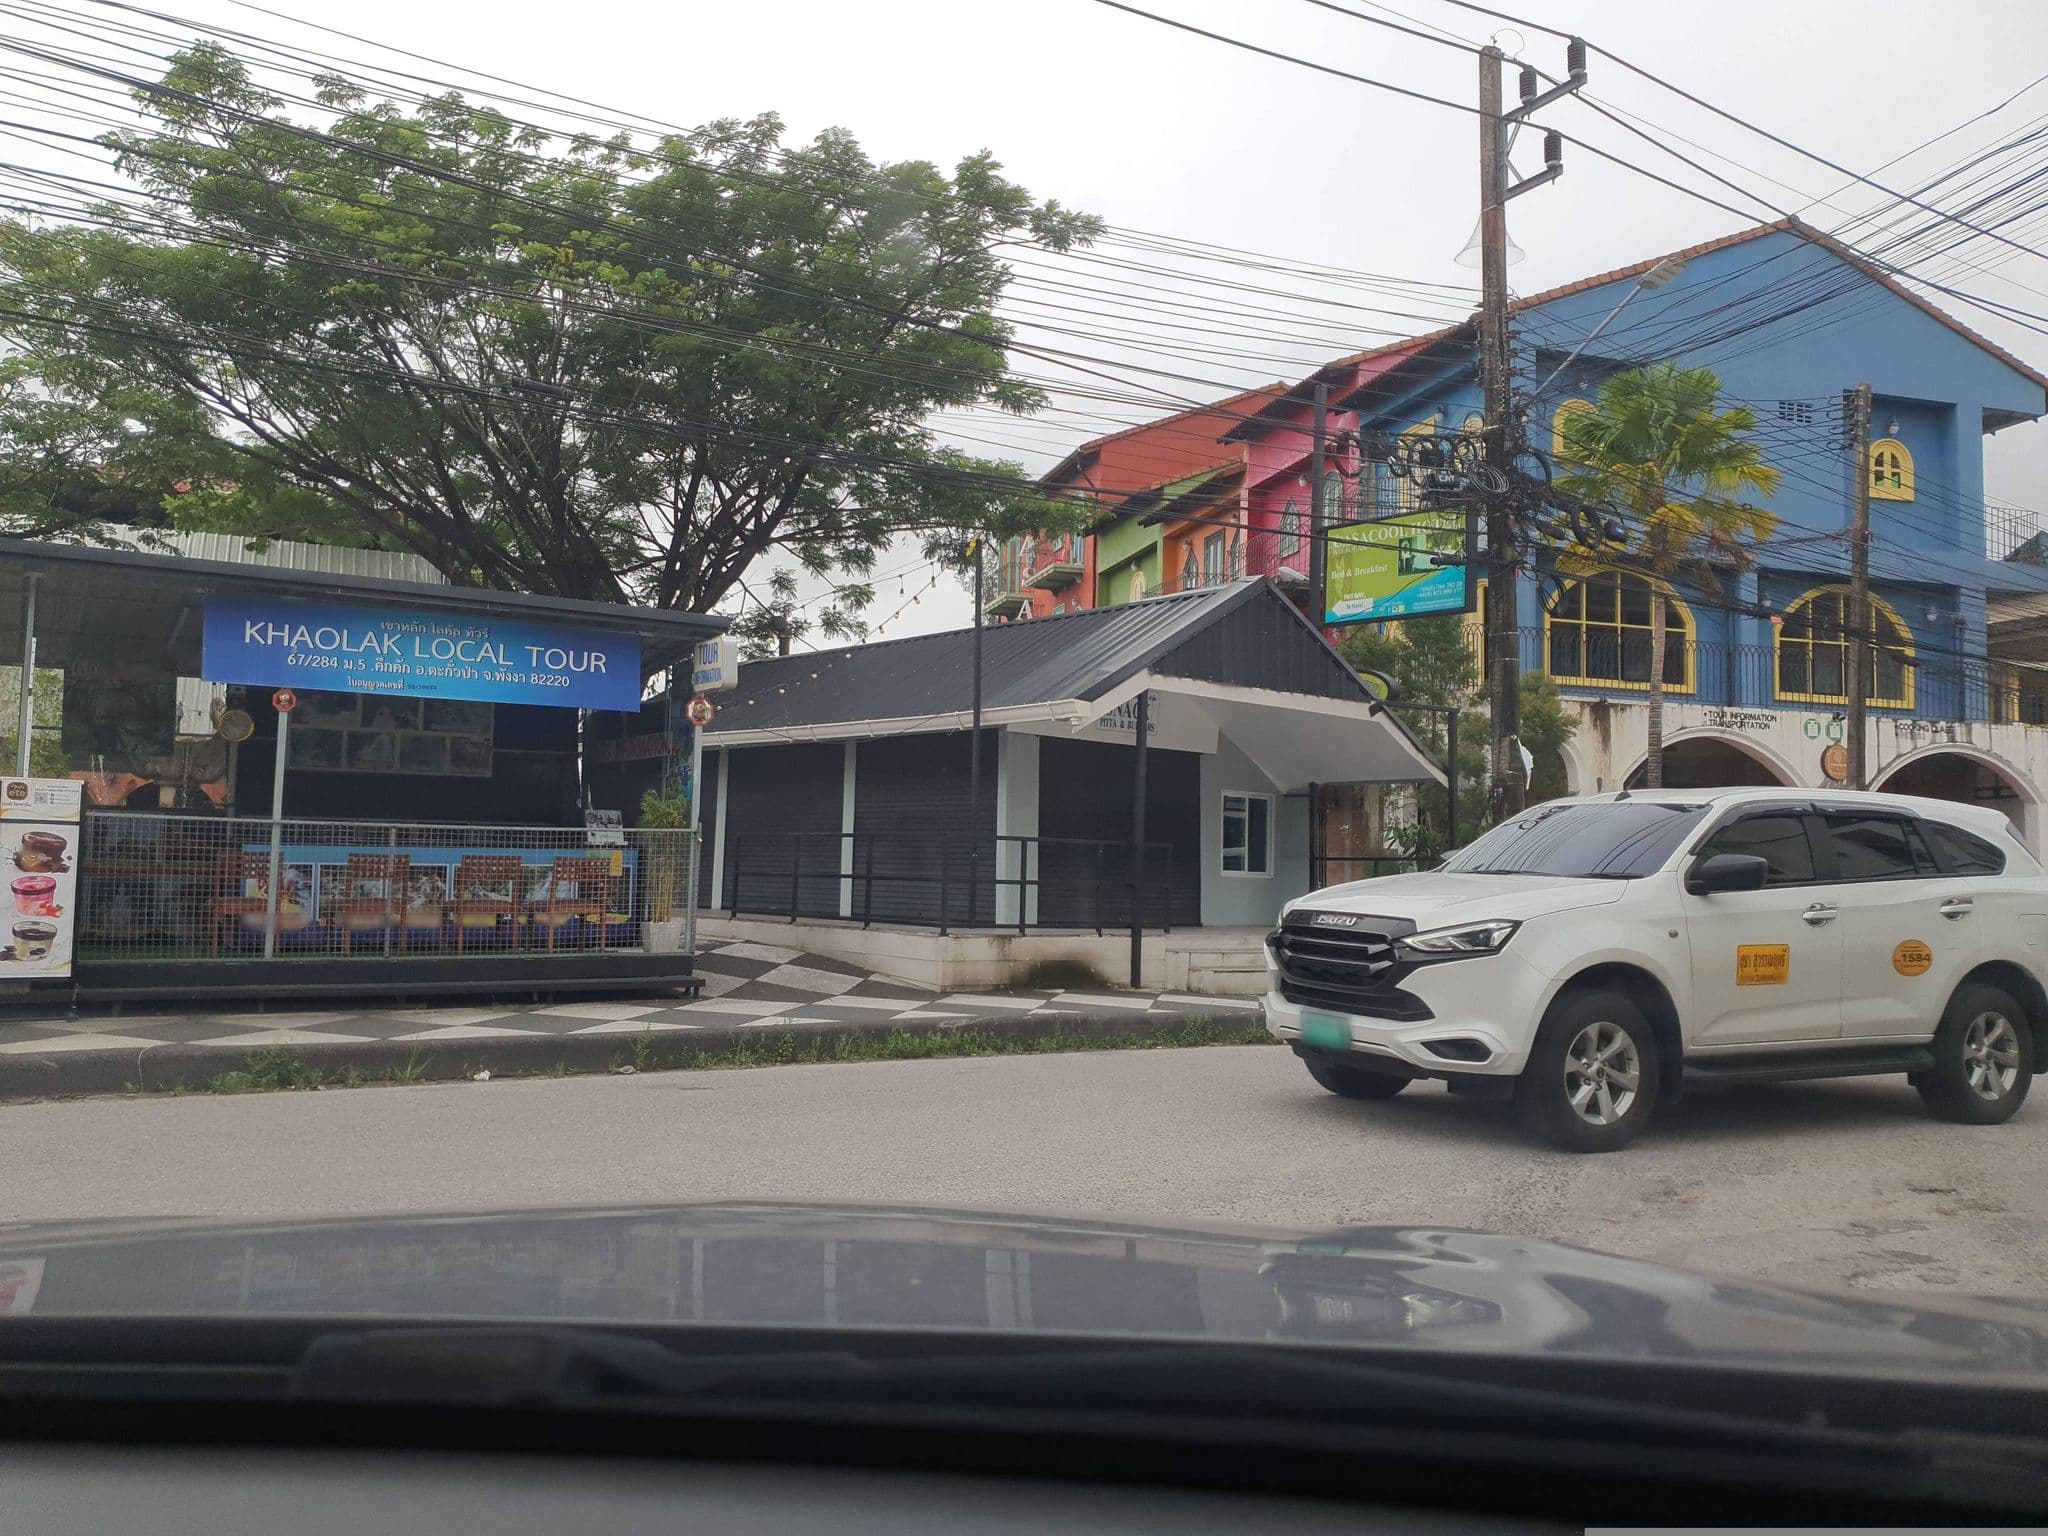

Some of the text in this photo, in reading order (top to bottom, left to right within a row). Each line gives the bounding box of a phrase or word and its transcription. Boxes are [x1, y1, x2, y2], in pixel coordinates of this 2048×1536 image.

[1354, 564, 1388, 576] Breakfast
[381, 620, 427, 634] เขาหลัก
[244, 620, 607, 674] KHAOLAK LOCAL TOUR
[698, 642, 719, 666] TOUR
[287, 653, 339, 669] 67/284
[343, 659, 366, 671] ม.5
[483, 666, 527, 684] จ.พังงา
[530, 673, 571, 688] 82220
[1708, 711, 1777, 722] TOUR INFORMATION
[1708, 719, 1771, 730] TRANSPORTATION
[1316, 914, 1357, 926] ISUZU
[1903, 953, 1931, 963] 1584
